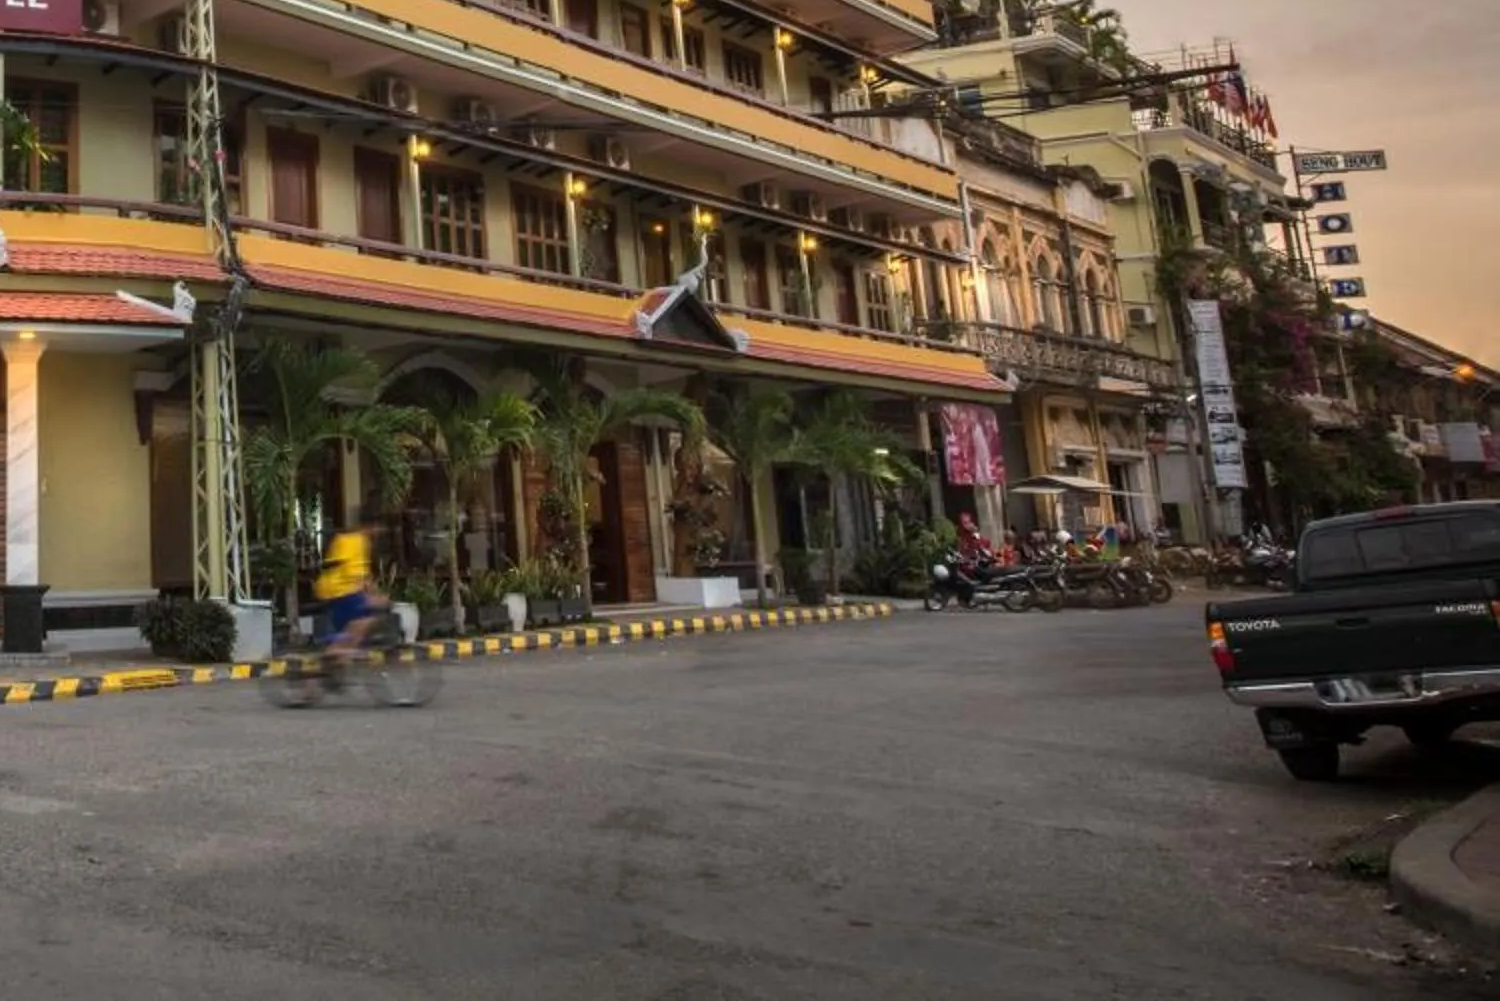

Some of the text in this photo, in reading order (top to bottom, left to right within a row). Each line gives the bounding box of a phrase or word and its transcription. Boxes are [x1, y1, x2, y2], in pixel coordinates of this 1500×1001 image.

[1301, 153, 1381, 170] SENG HOUT
[1227, 619, 1281, 632] TOYOTA
